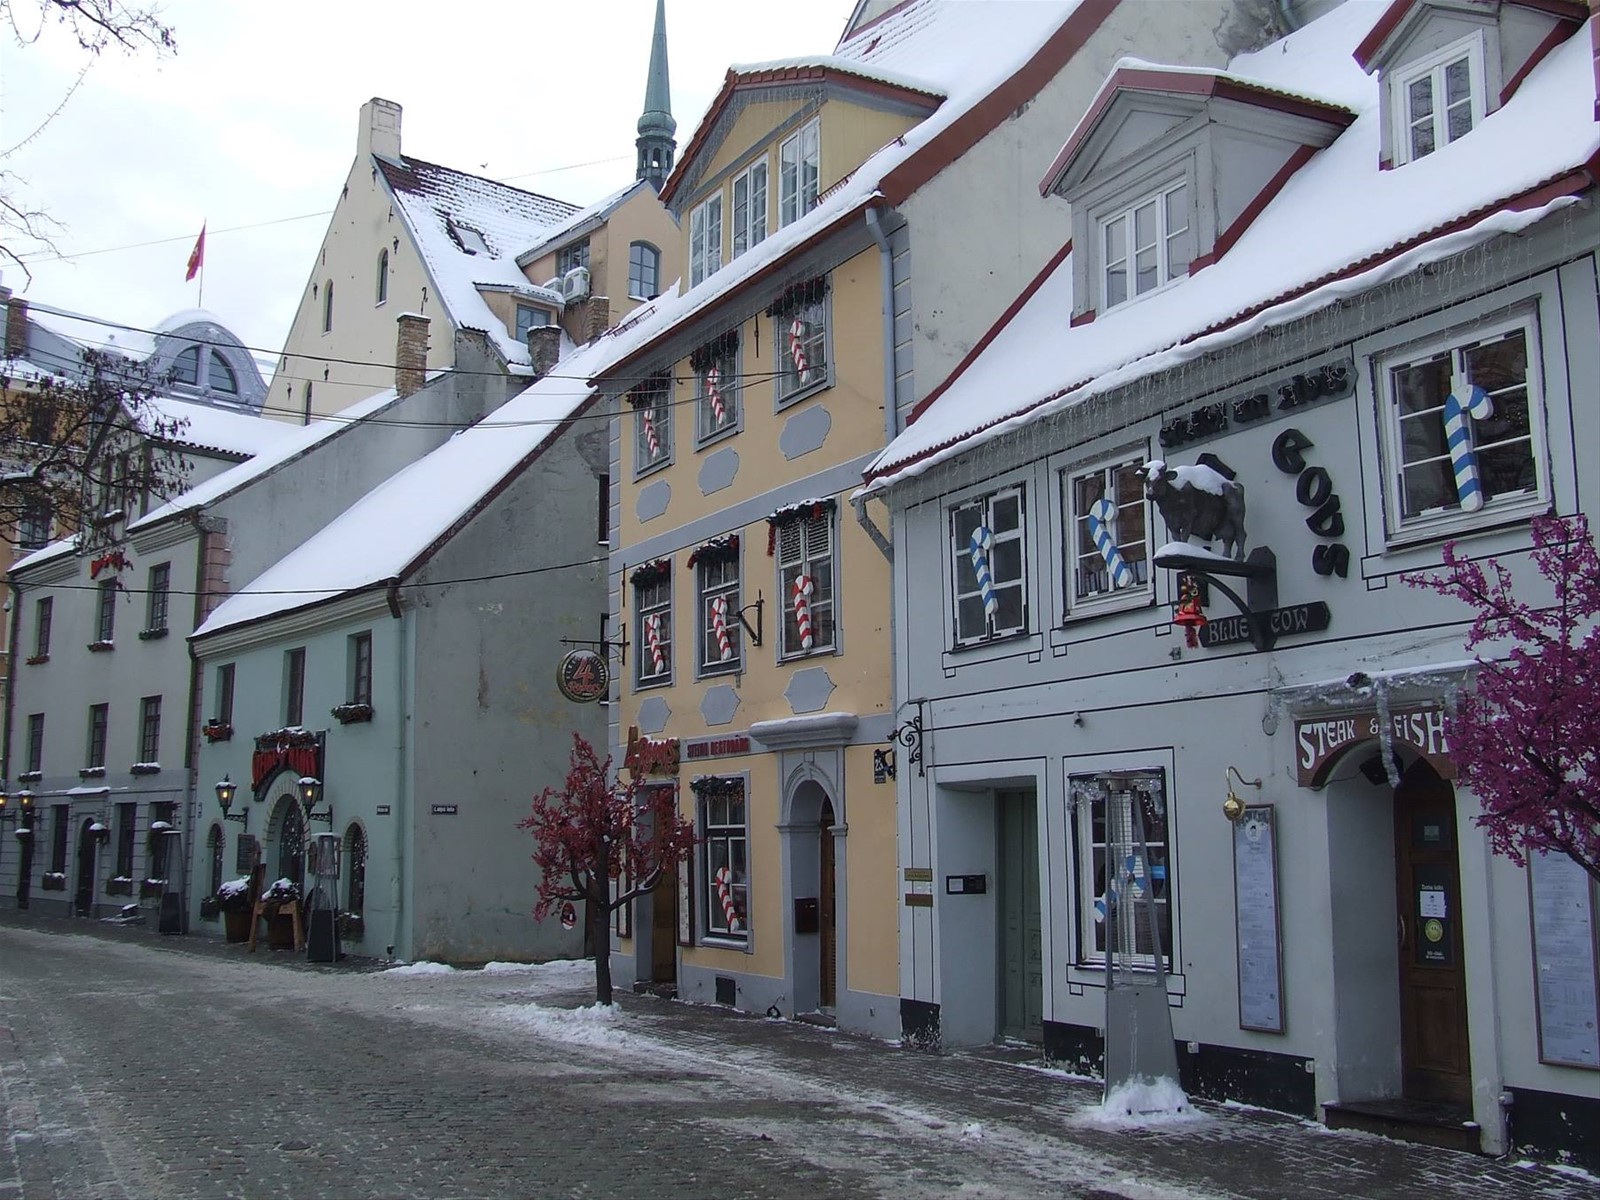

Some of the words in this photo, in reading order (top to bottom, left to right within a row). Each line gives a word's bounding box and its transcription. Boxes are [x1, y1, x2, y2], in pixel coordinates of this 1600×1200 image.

[1209, 618, 1249, 644] BLUE
[1270, 607, 1309, 634] COW
[573, 656, 594, 685] 4
[1300, 719, 1356, 770] STEAK
[1369, 717, 1380, 735] &
